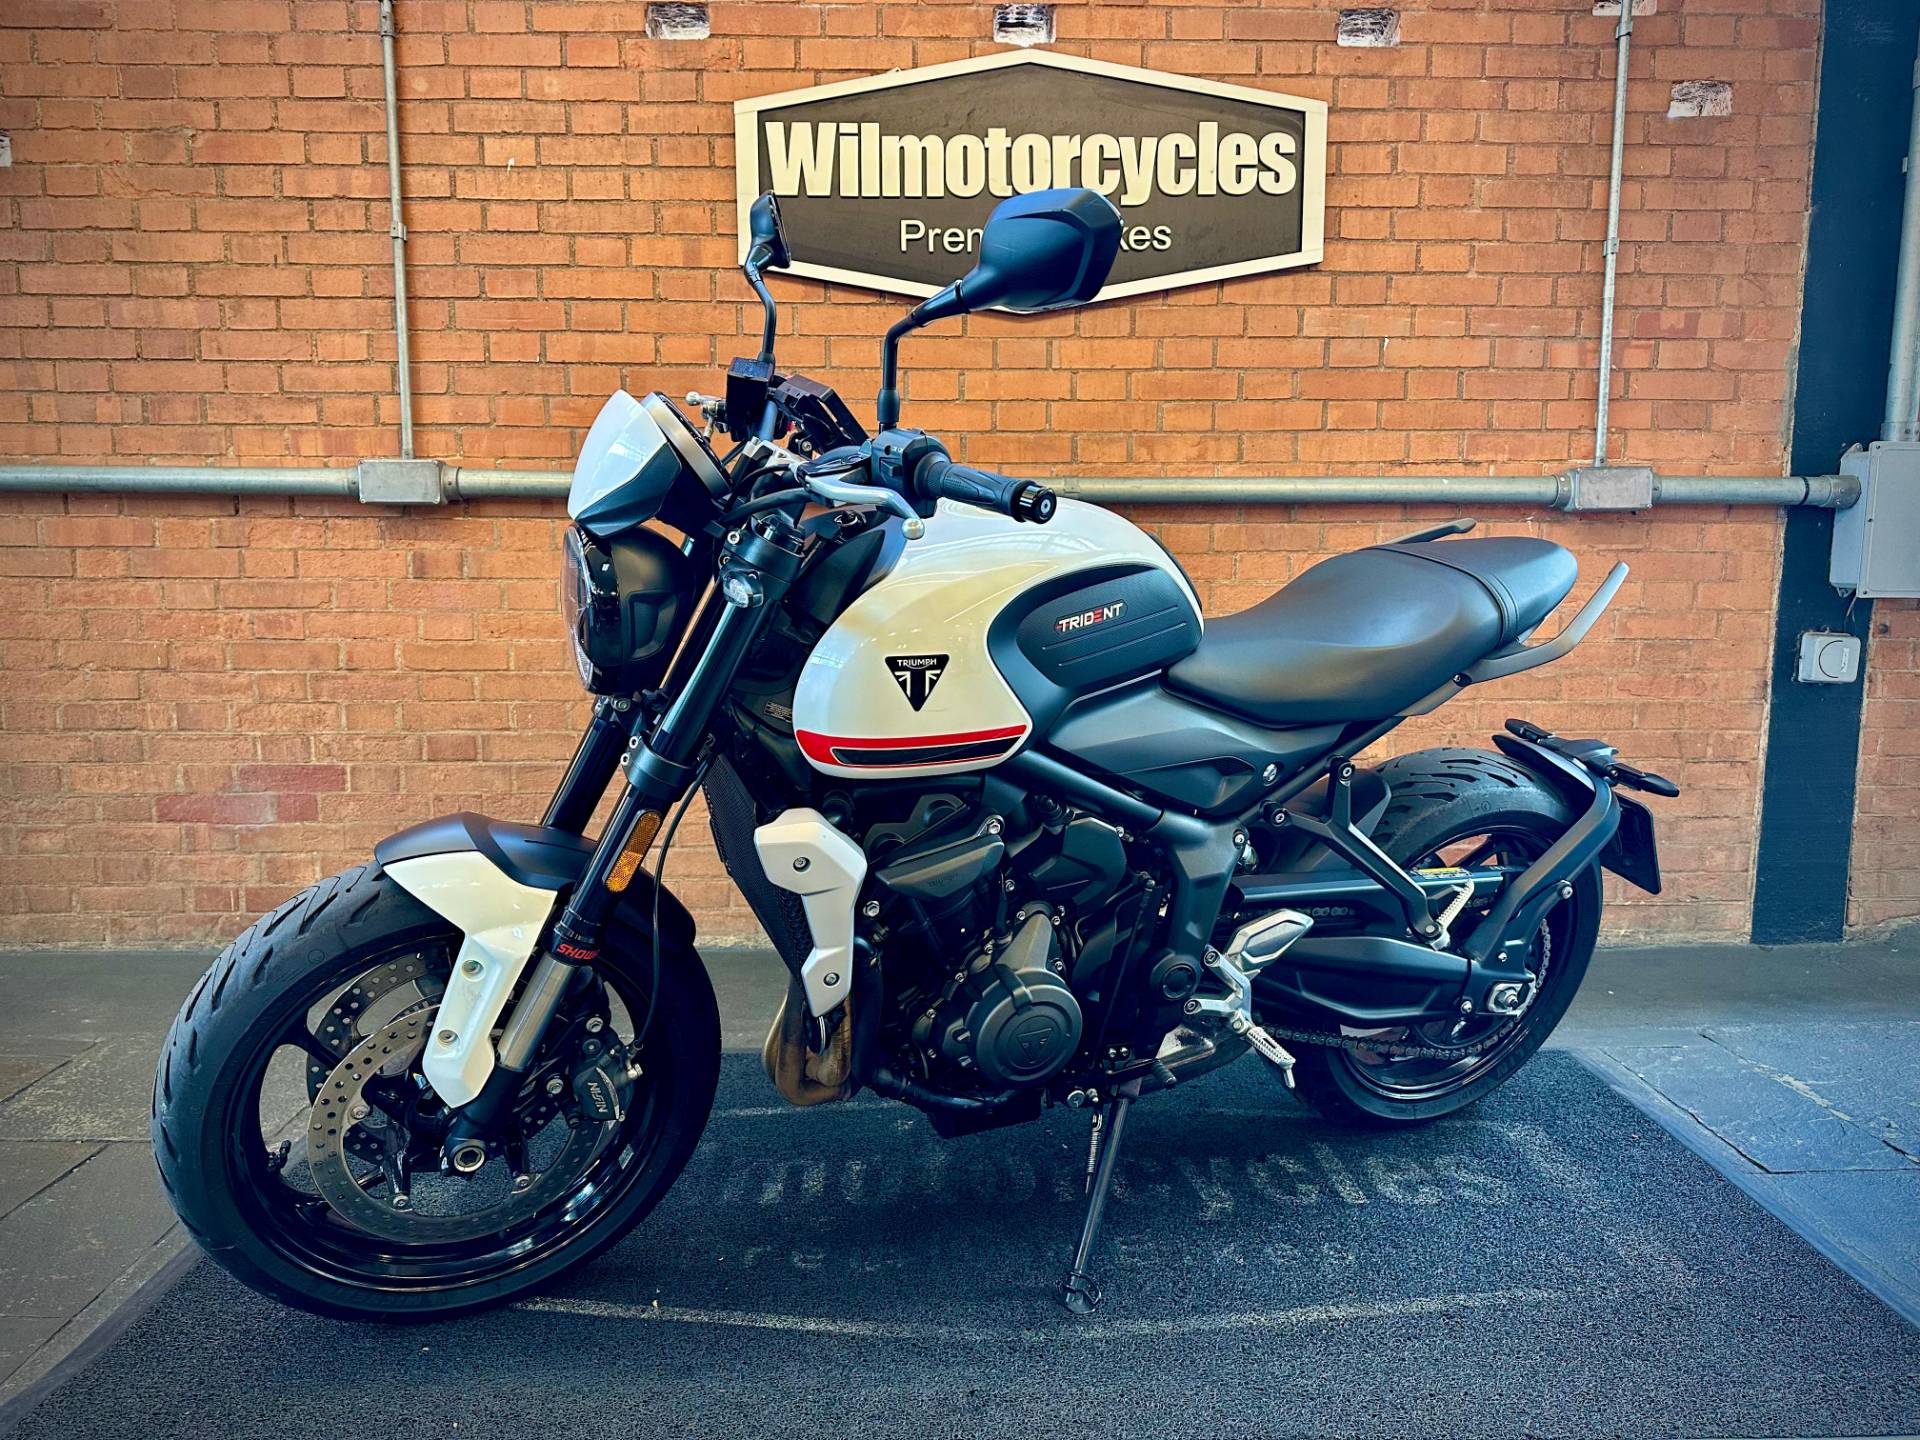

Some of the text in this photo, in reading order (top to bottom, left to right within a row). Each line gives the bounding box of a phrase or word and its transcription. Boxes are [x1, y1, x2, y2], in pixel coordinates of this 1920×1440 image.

[765, 121, 1297, 207] Wilmotorcycles
[1057, 602, 1124, 632] TRIDENT
[896, 658, 937, 667] TRIUMPH
